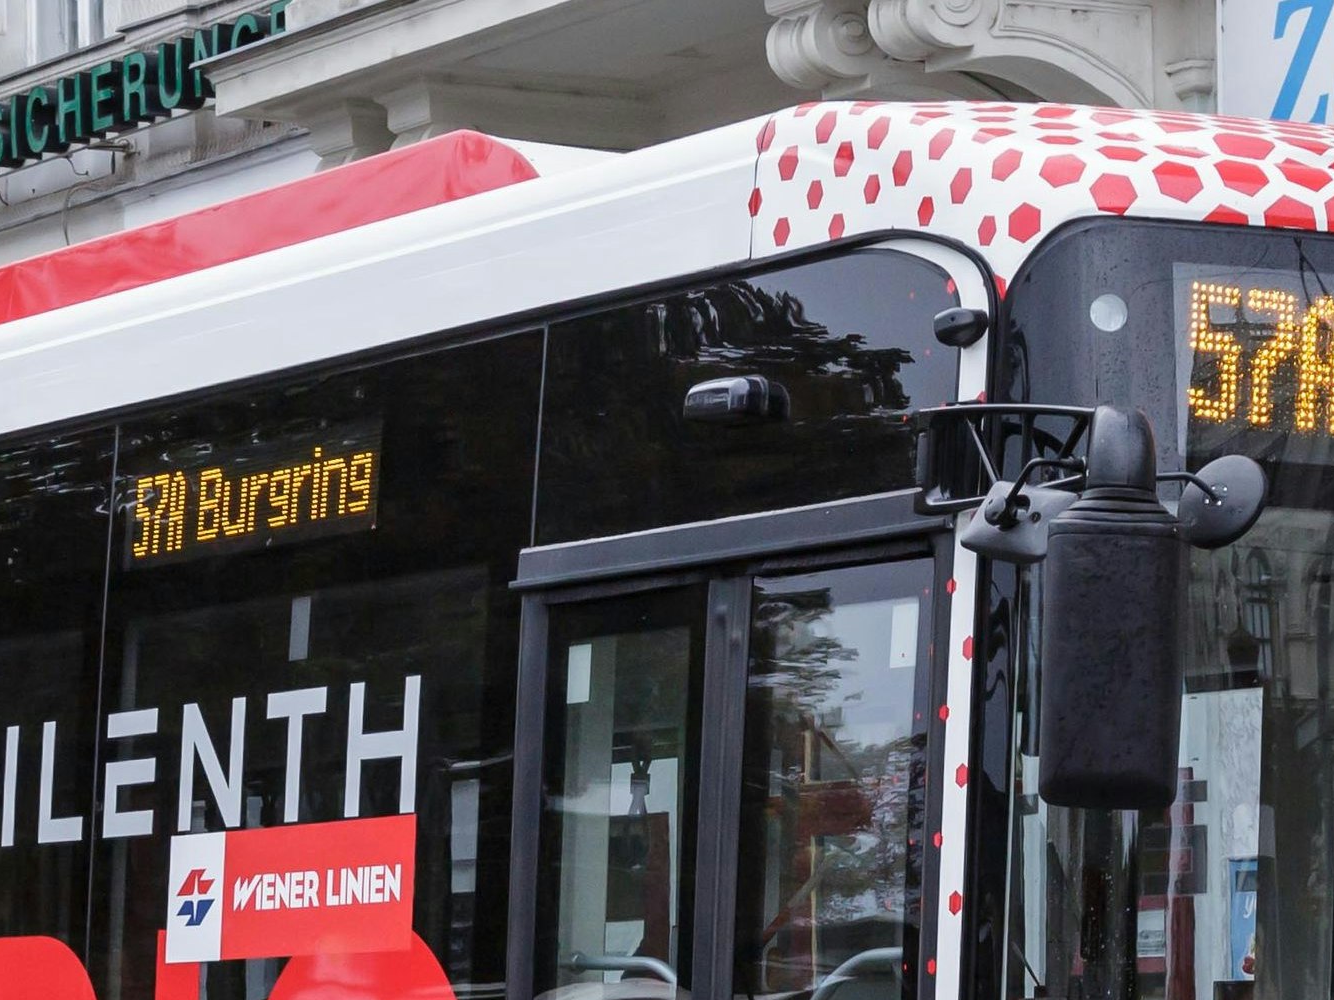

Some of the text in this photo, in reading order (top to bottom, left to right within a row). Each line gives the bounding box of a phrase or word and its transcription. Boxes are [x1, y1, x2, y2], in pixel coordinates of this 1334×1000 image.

[134, 447, 373, 558] 57A Burgring
[233, 863, 403, 912] WIENER LINIEN
